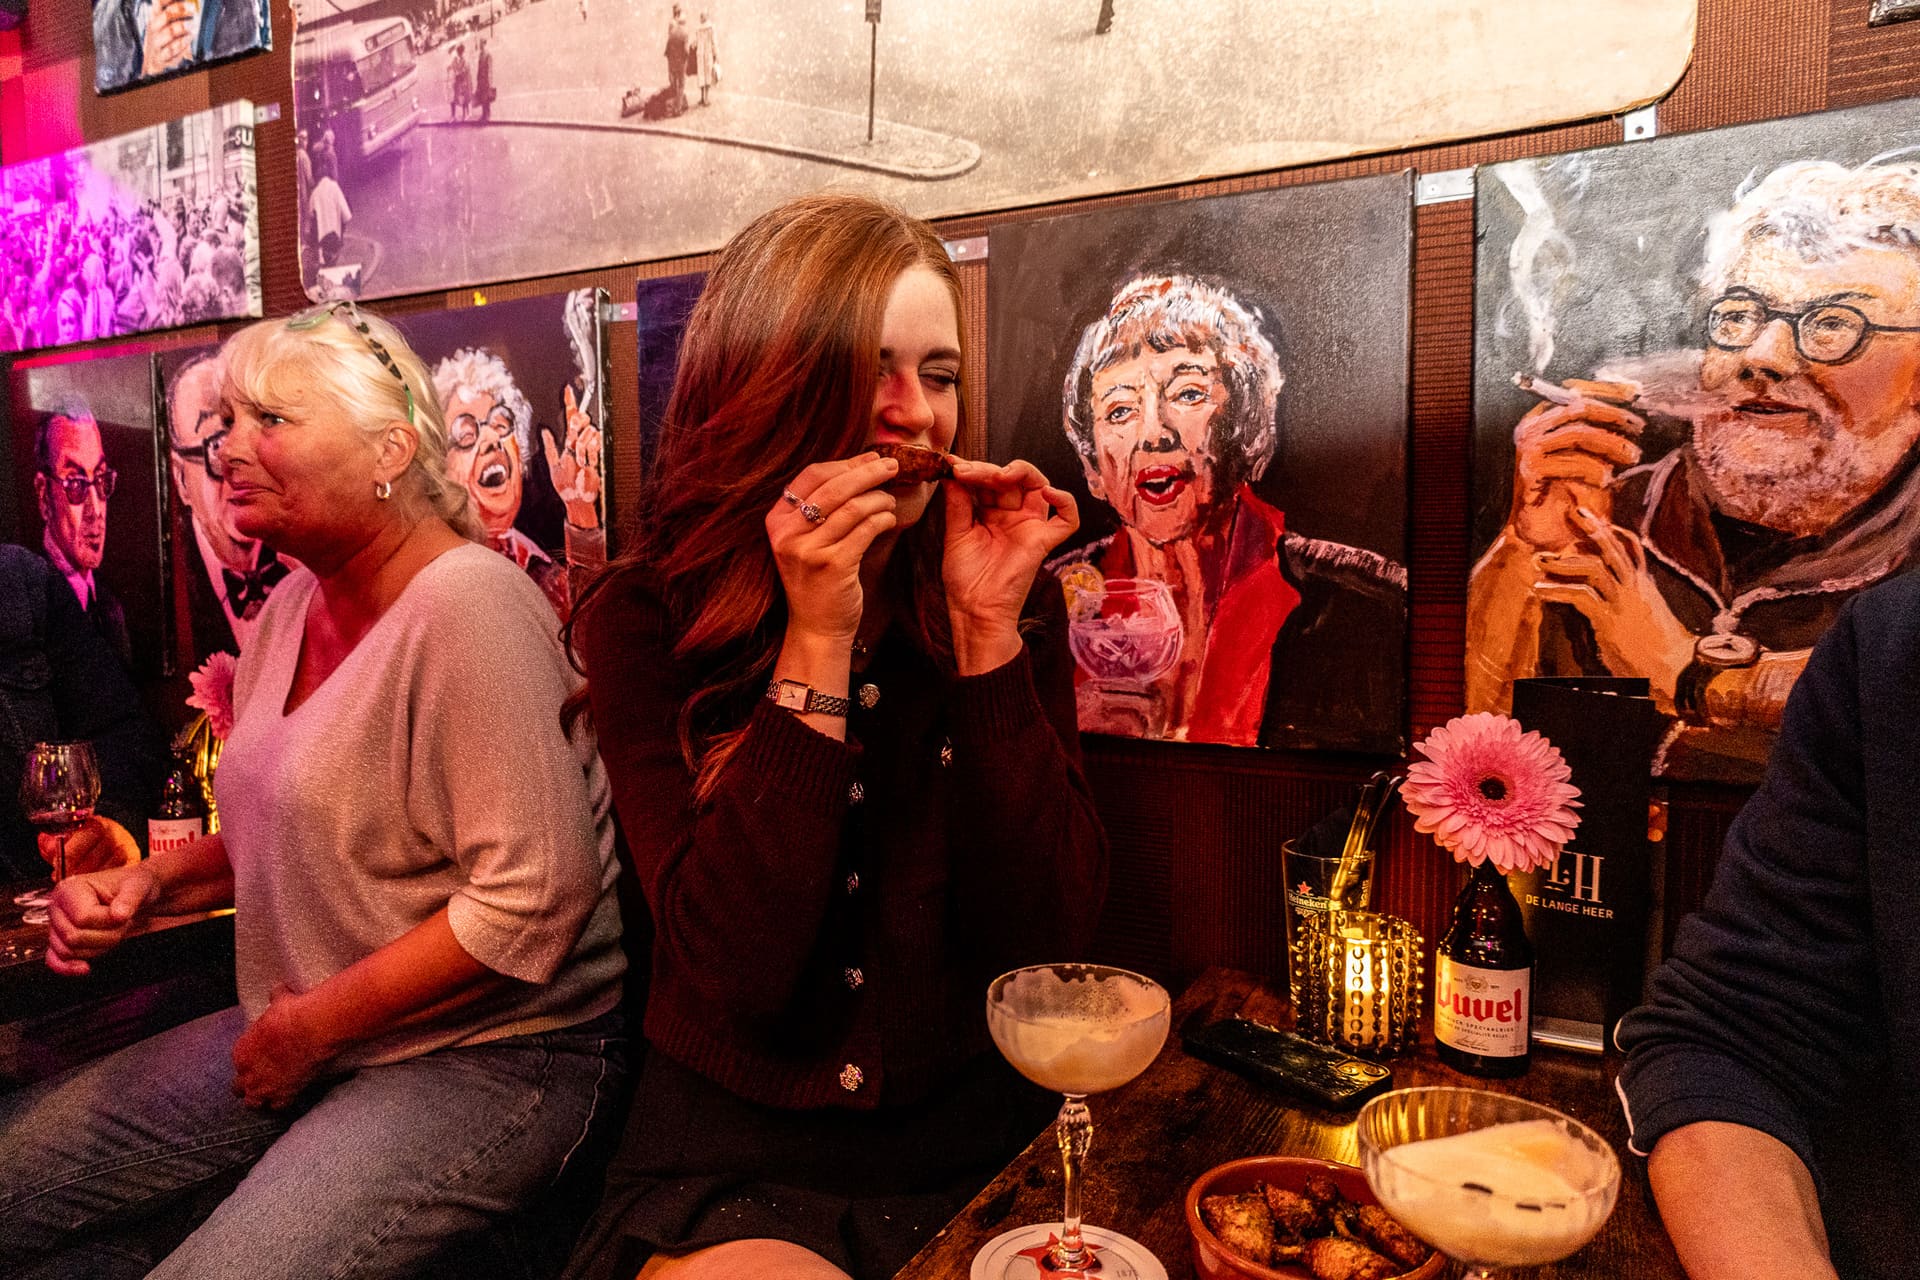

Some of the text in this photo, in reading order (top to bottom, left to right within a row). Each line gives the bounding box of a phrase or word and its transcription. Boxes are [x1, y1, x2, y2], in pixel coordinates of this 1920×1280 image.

[1525, 894, 1614, 919] DE LANGE HEER
[1437, 971, 1522, 1023] Duvel
